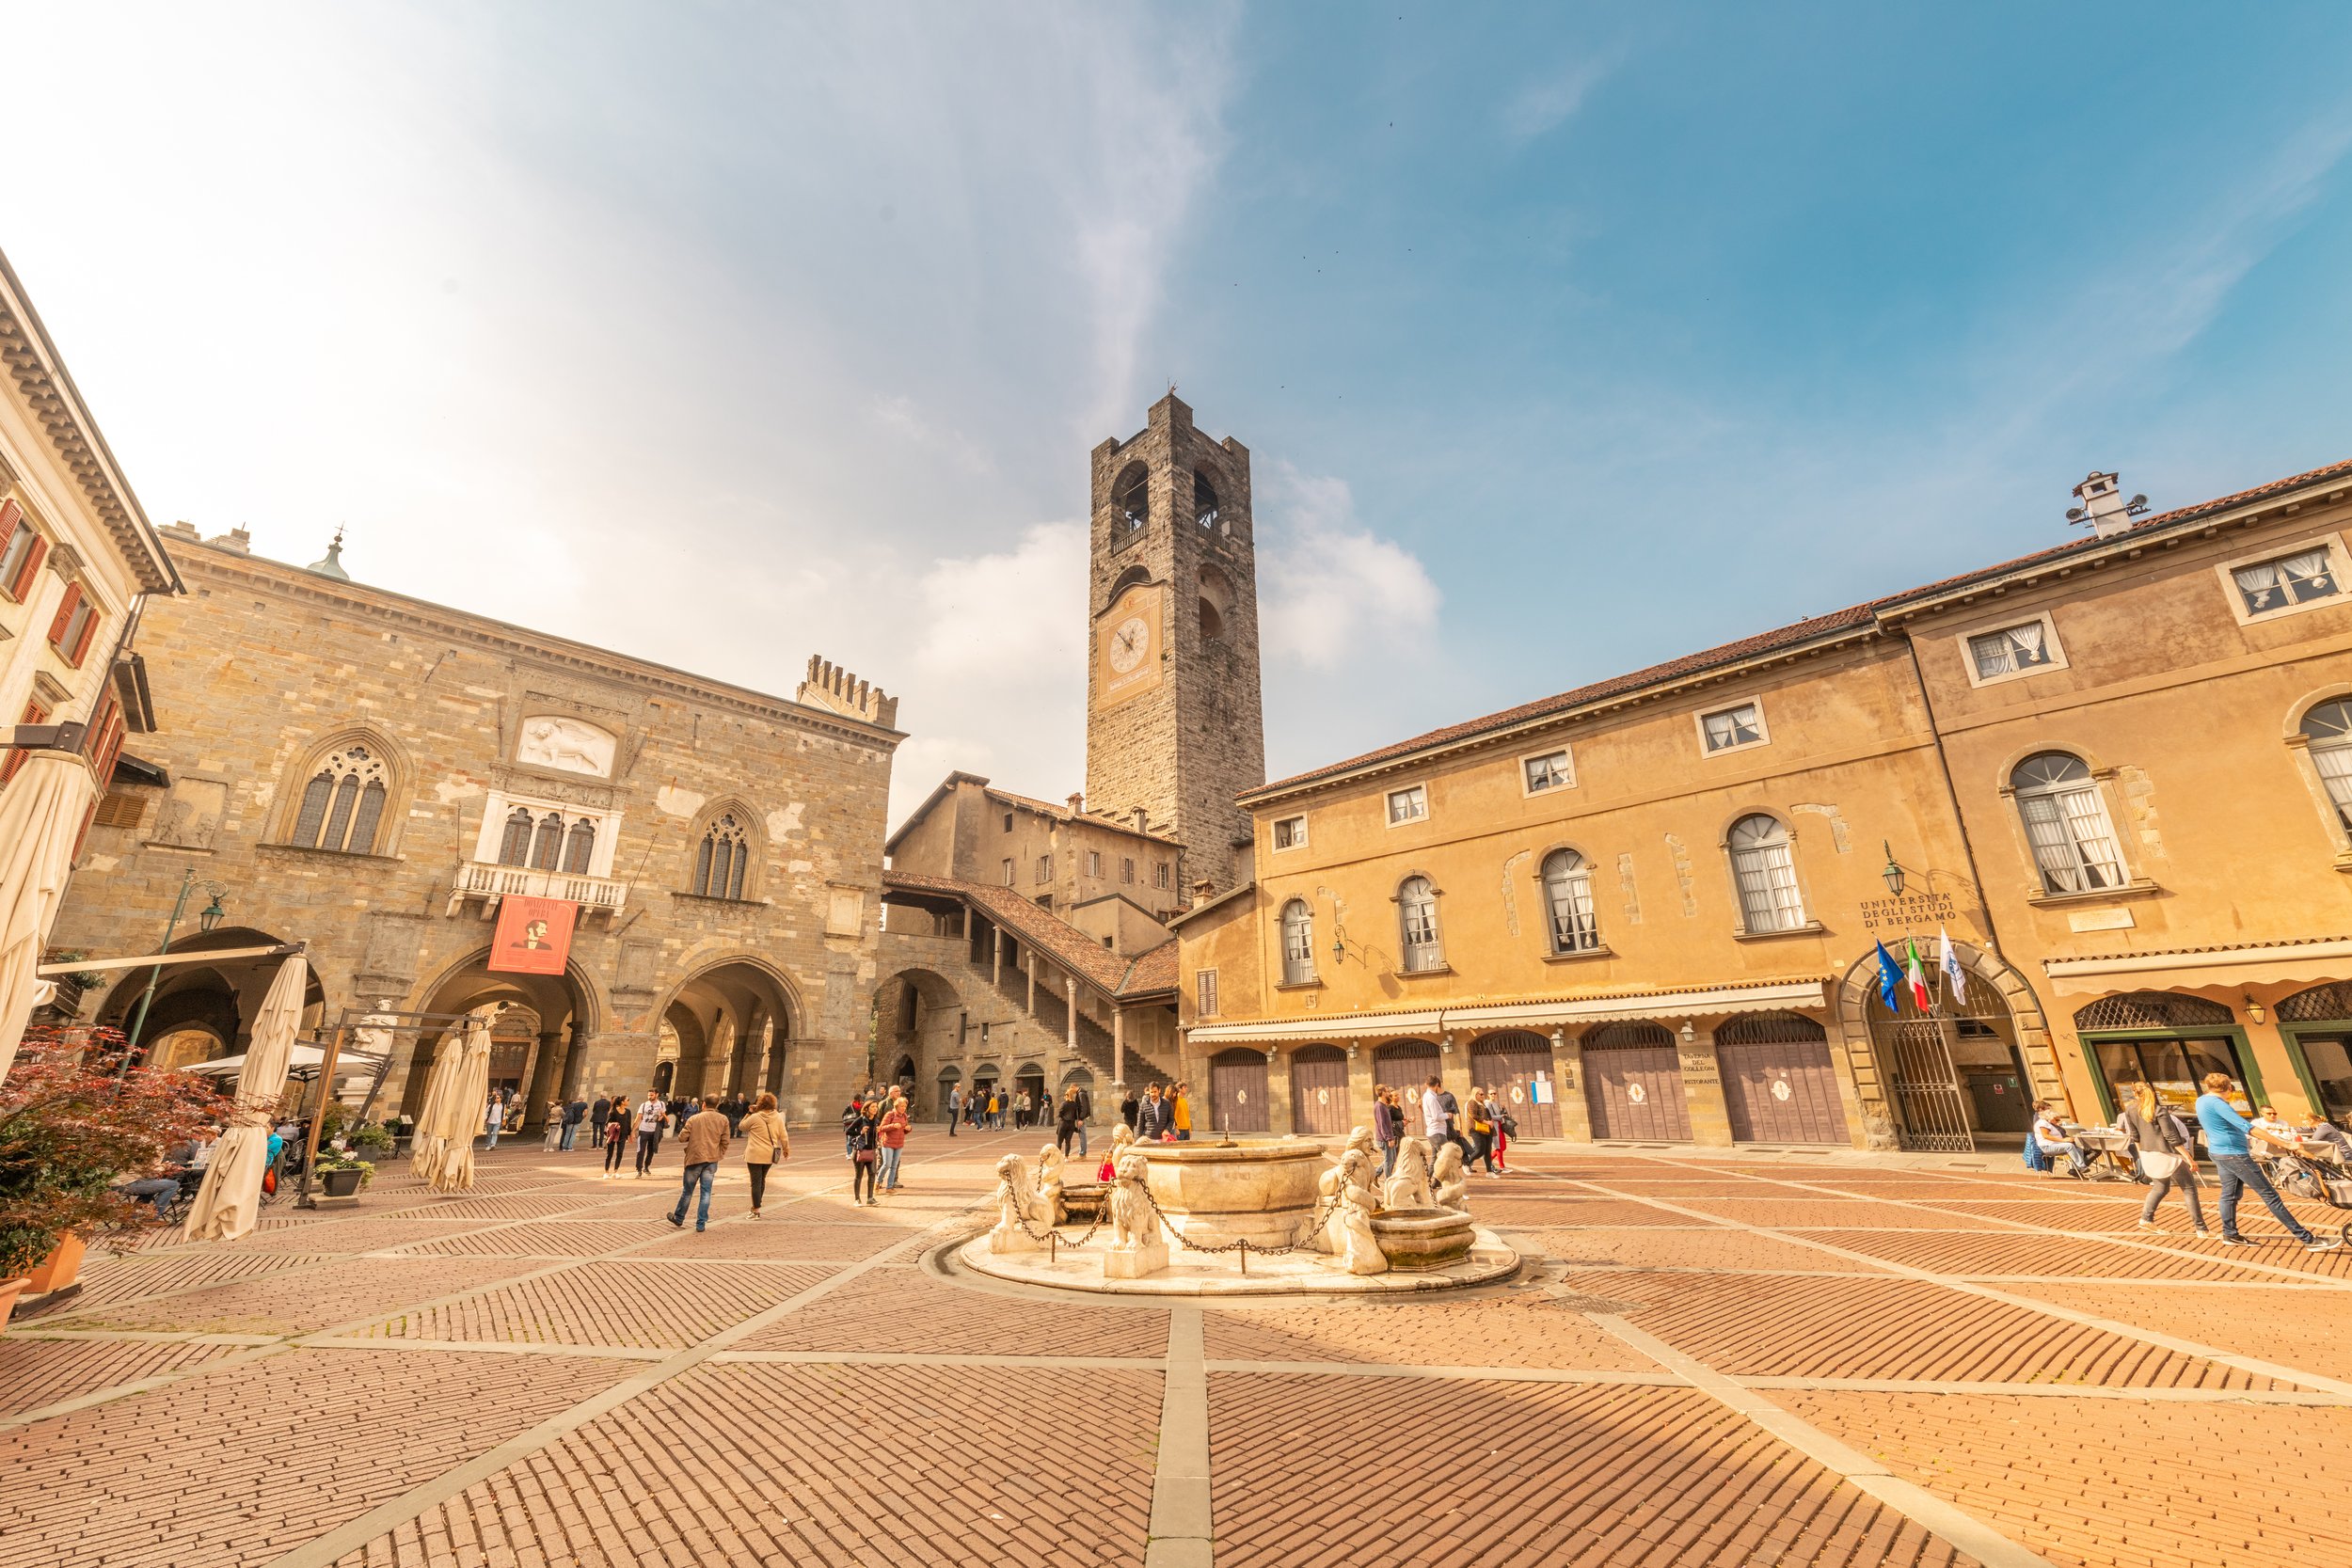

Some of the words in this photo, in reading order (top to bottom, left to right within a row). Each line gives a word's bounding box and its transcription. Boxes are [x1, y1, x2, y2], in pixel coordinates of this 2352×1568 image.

[1863, 908, 1905, 919] DEGLI
[1910, 902, 1954, 914] STUDI
[1865, 919, 1879, 928] DI
[1887, 911, 1956, 926] BERGAMO
